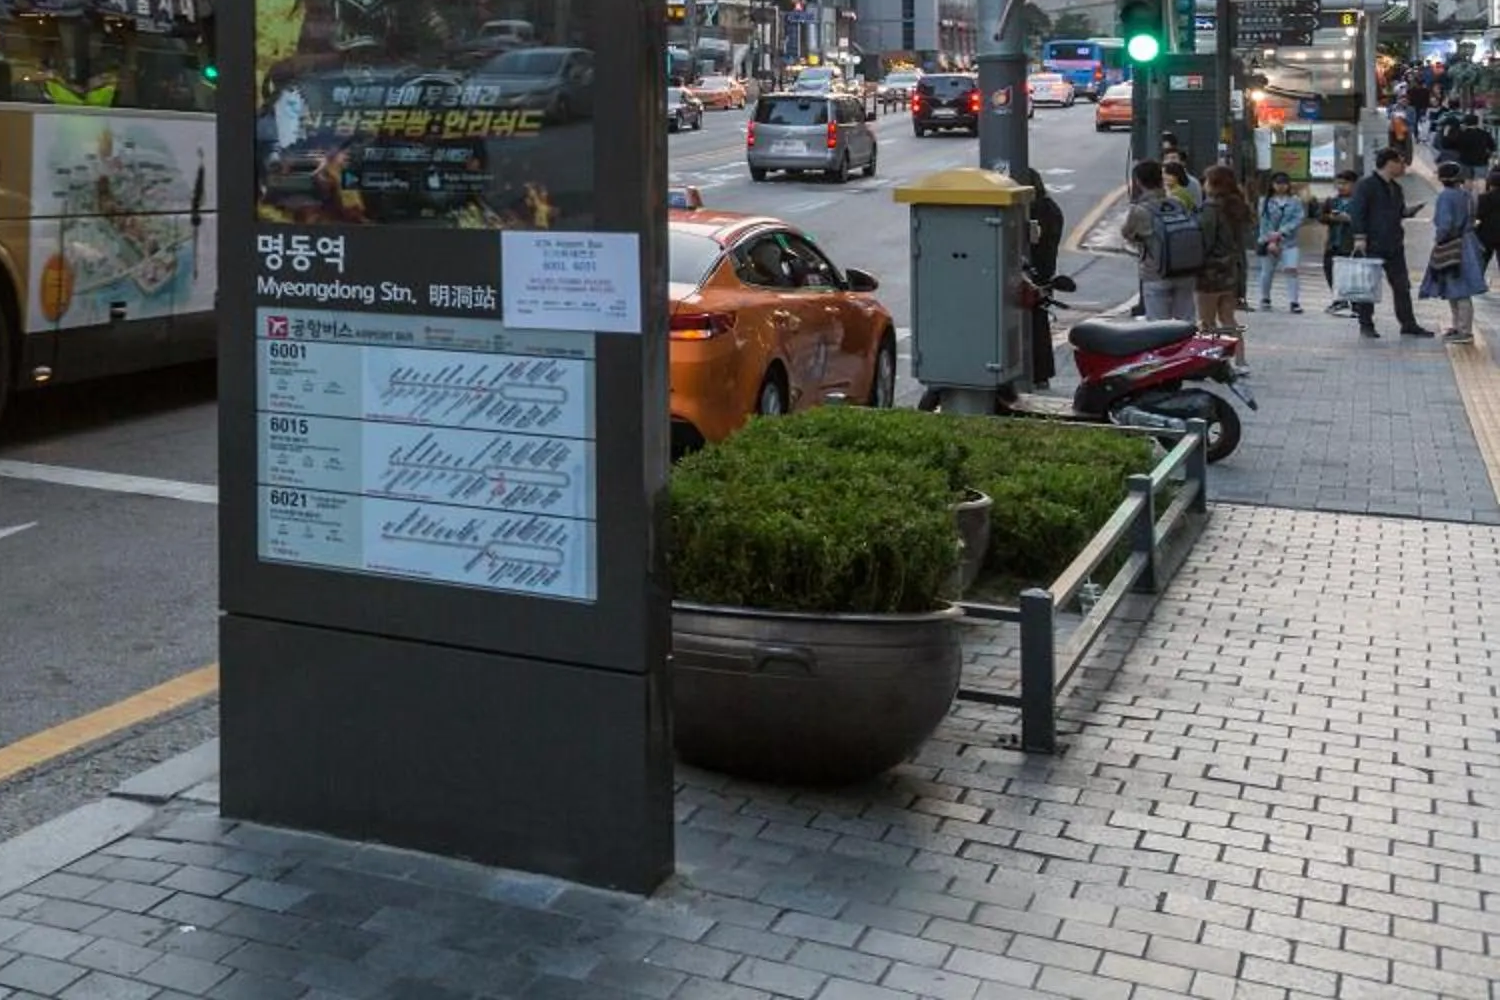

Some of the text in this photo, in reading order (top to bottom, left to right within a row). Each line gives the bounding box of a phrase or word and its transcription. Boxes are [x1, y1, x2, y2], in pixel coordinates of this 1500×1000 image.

[257, 233, 346, 273] 명동역
[257, 275, 417, 305] Myeongdong Stn.
[429, 284, 498, 310] 明洞站
[290, 319, 353, 339] 공항버스
[269, 342, 308, 359] 6001
[269, 416, 309, 434] 6015
[270, 489, 308, 508] 6021
